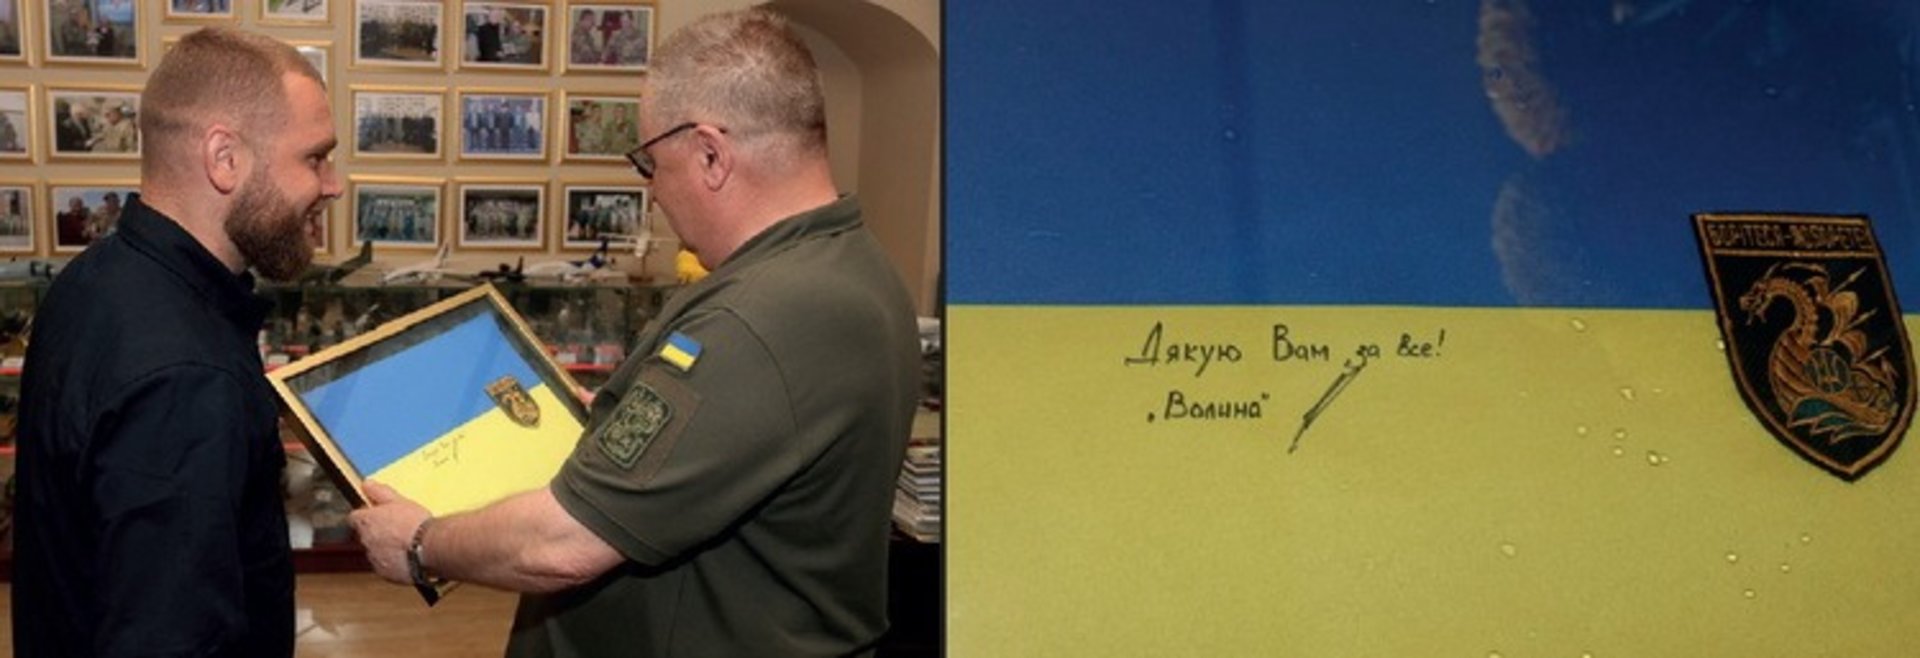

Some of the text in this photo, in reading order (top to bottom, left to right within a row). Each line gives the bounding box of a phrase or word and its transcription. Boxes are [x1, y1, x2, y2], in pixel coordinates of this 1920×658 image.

[1124, 321, 1446, 378] Дякую Вам за все!
